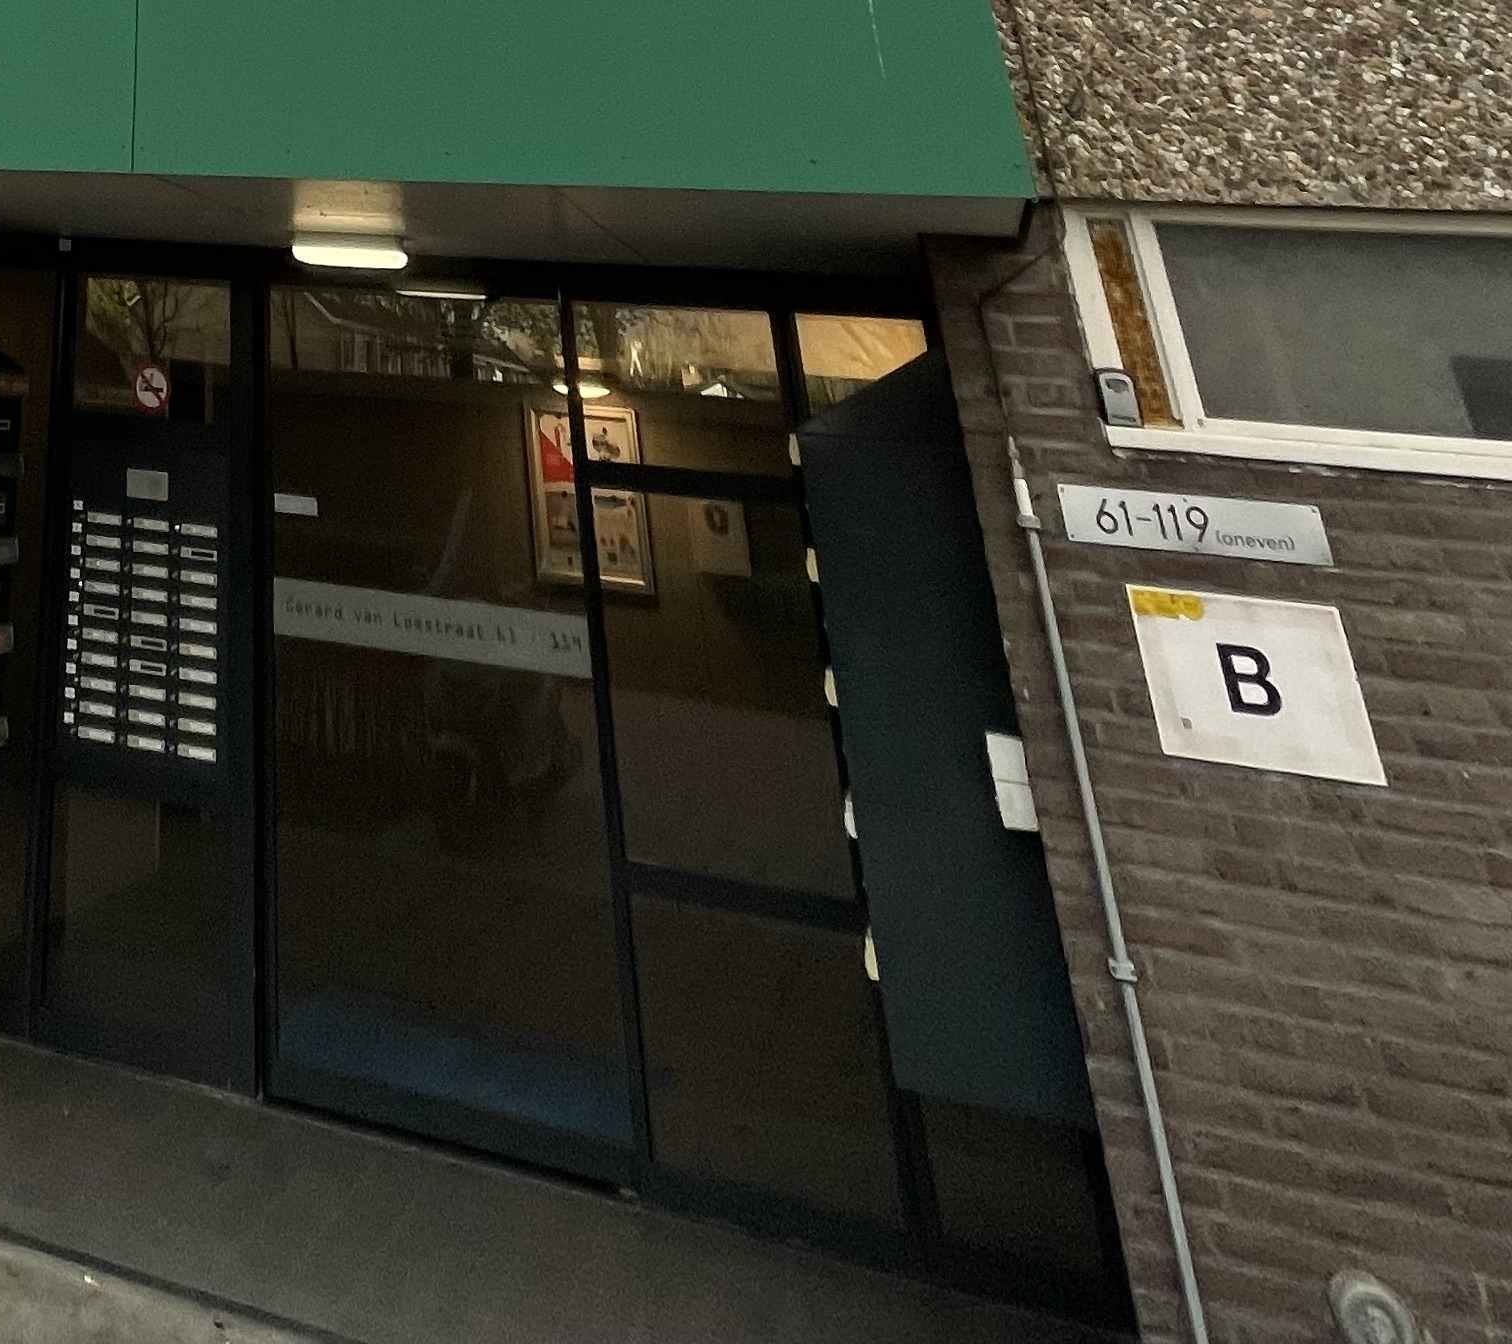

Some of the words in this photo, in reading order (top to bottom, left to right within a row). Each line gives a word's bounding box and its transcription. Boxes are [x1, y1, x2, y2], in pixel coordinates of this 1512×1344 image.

[1095, 498, 1209, 543] 61-119
[1215, 529, 1296, 551] (oneven)
[352, 609, 384, 626] van
[1216, 642, 1282, 716] B
